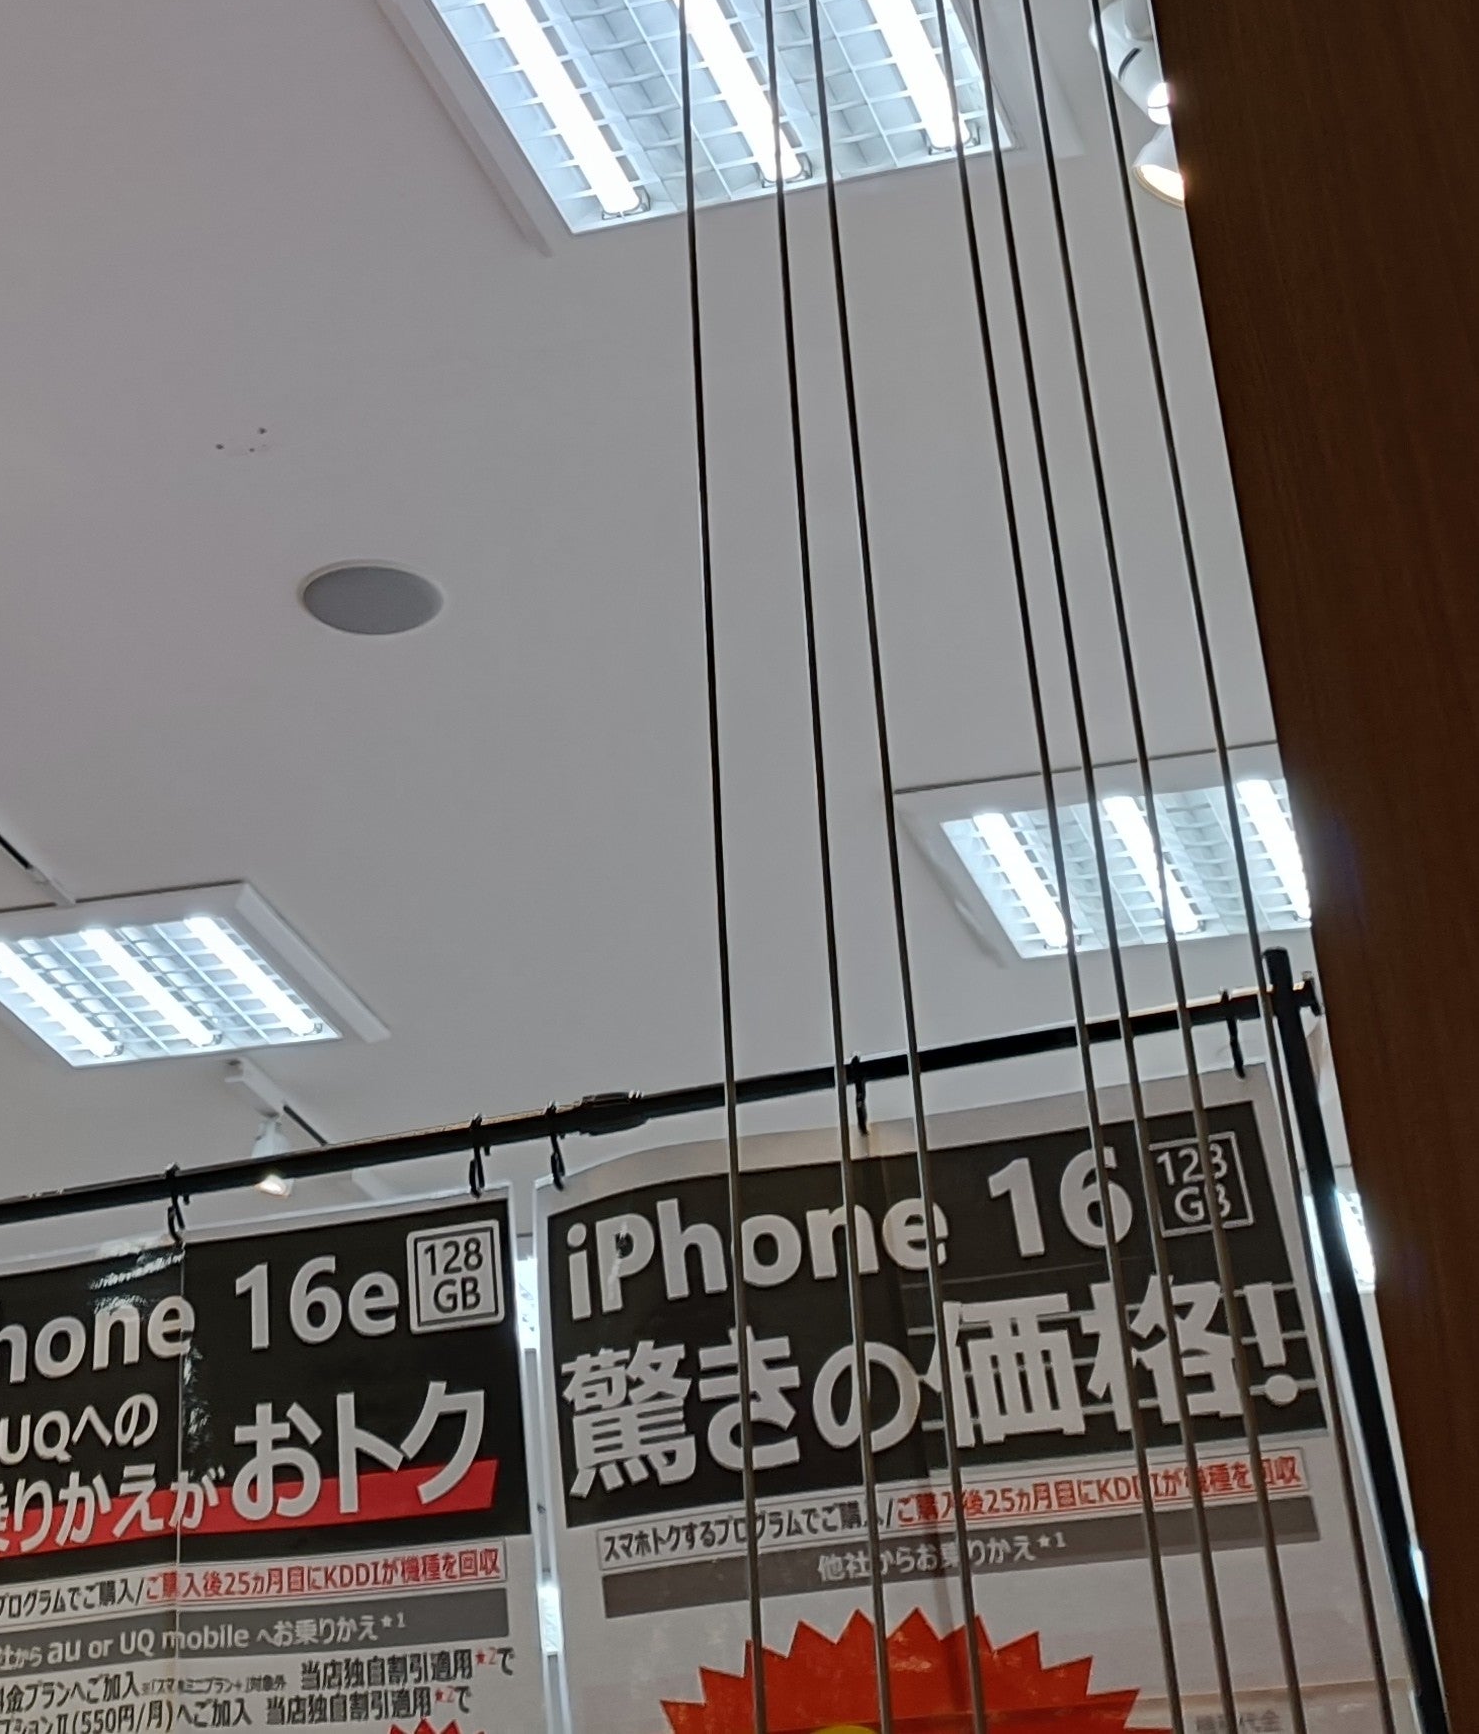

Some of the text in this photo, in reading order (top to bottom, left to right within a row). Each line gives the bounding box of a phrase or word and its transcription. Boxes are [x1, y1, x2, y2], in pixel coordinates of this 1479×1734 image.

[423, 1237, 484, 1277] 128
[567, 1146, 1132, 1321] iPhone 16
[234, 1255, 400, 1351] 16e
[432, 1277, 481, 1314] GB
[561, 1274, 1298, 1499] 驚きの価格!
[231, 1380, 487, 1522] おトク
[47, 1639, 81, 1664] au
[88, 1637, 114, 1659] or
[119, 1629, 155, 1657] UQ
[162, 1624, 249, 1651] mobile
